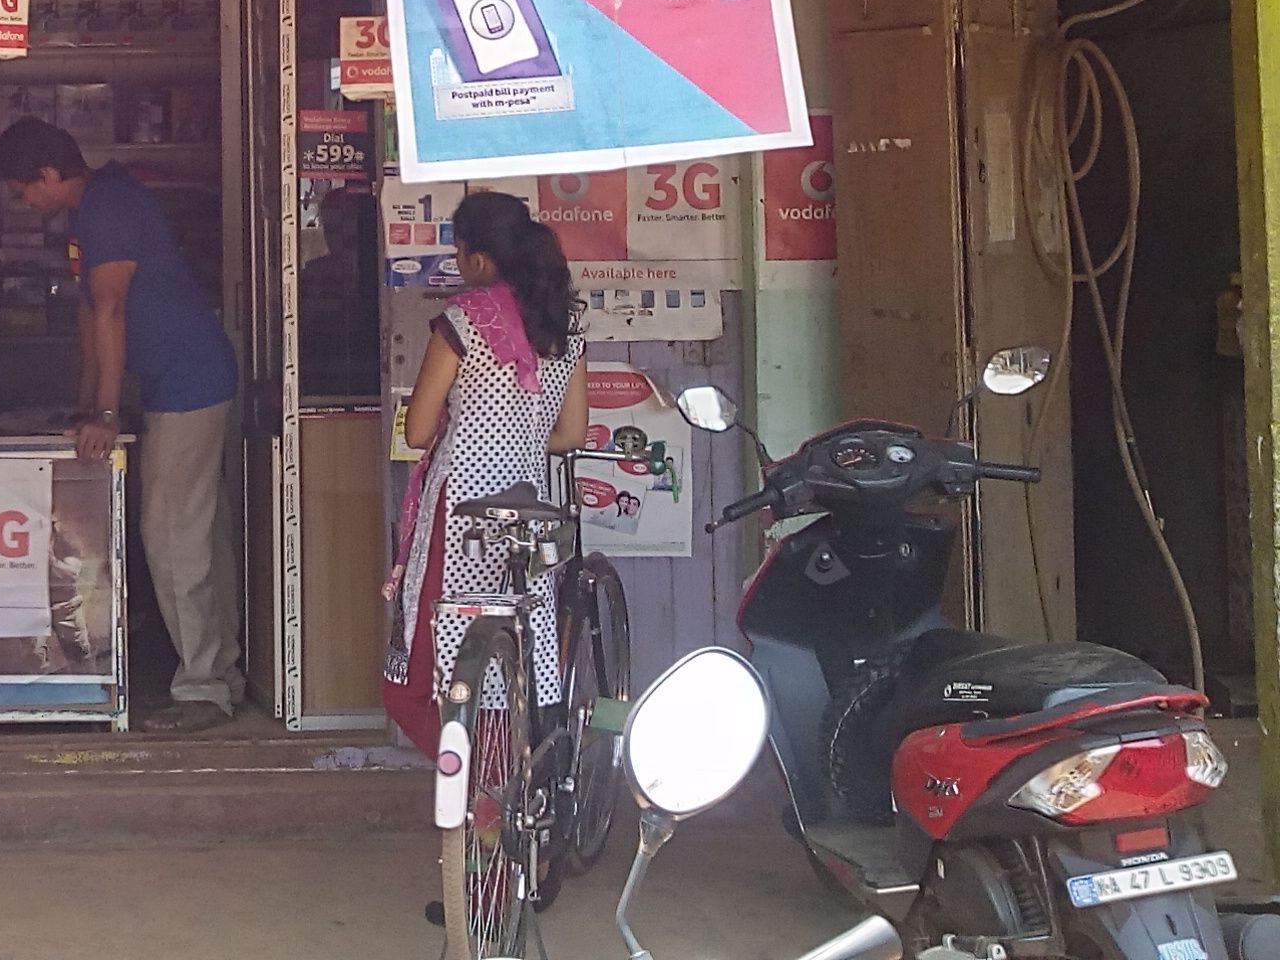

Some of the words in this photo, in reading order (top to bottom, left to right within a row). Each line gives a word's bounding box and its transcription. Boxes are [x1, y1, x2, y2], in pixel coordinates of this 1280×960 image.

[451, 89, 494, 100] Postpaid
[495, 87, 511, 96] bill
[512, 84, 556, 97] payment
[471, 99, 493, 108] with
[324, 133, 344, 143] Dial
[645, 162, 720, 211] 3G
[539, 206, 614, 222] odafone
[778, 204, 835, 220] vodaf
[581, 267, 645, 280] Available
[647, 267, 677, 279] here
[1121, 852, 1169, 867] HONDA
[1159, 867, 1174, 886] L
[1179, 857, 1231, 881] 9309
